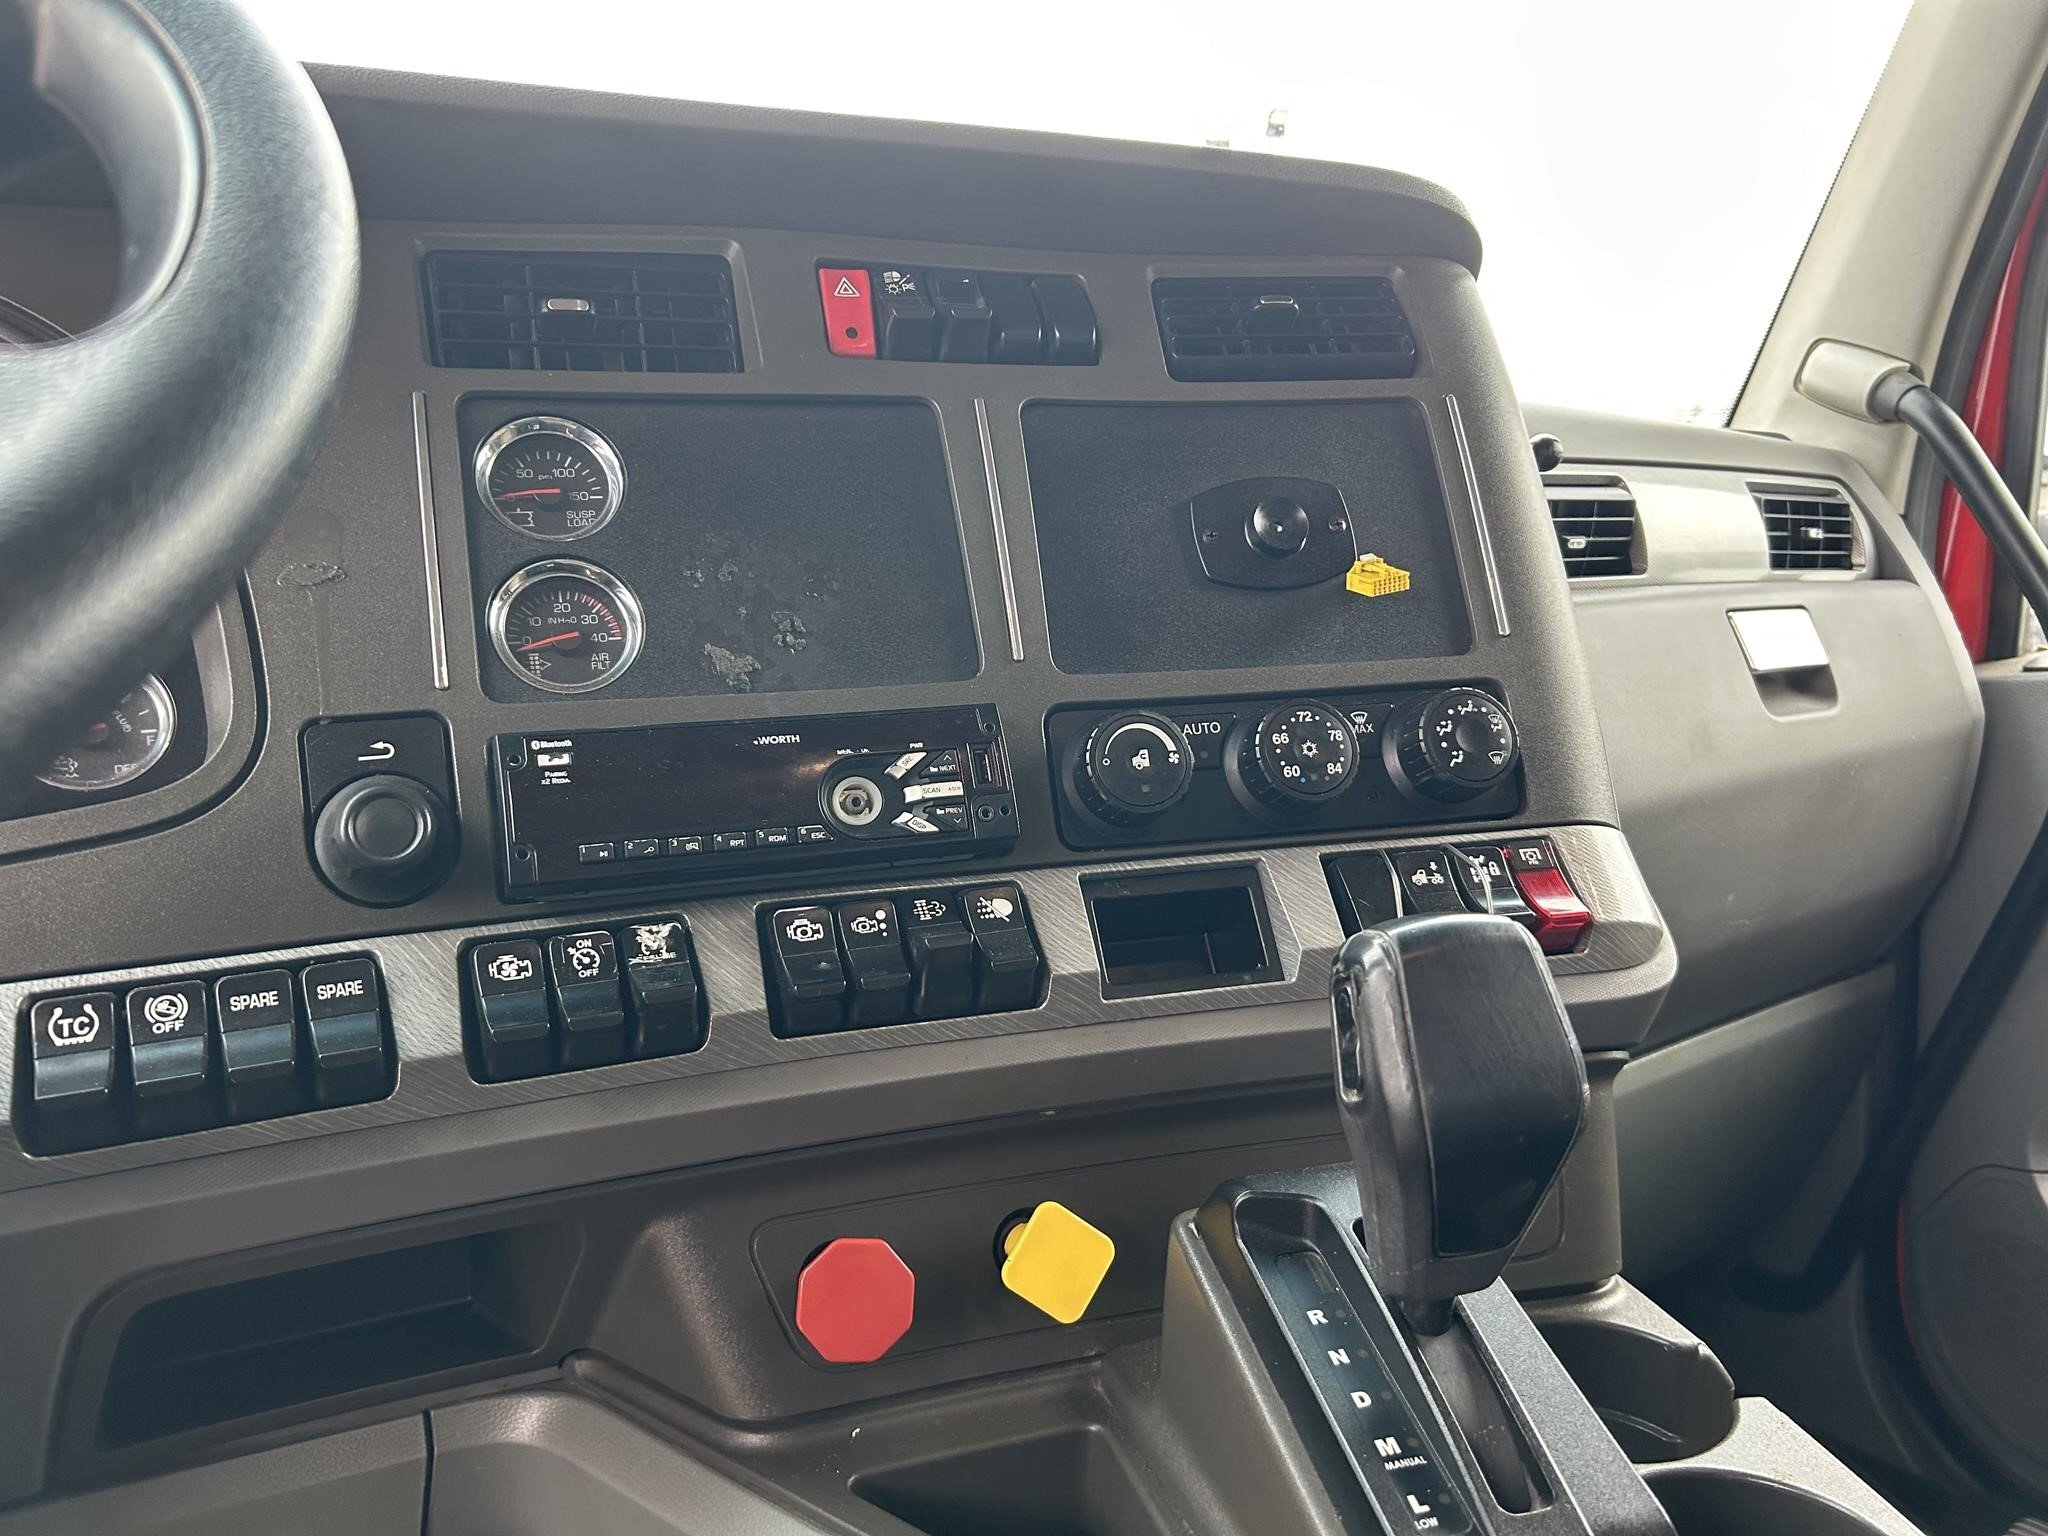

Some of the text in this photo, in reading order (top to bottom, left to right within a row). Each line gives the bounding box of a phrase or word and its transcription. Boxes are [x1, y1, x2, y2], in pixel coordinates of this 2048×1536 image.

[516, 468, 533, 479] 50
[552, 468, 576, 478] 100
[566, 510, 596, 519] SUSP
[553, 602, 572, 613] 20
[529, 616, 542, 627] 10
[580, 614, 599, 625] 30
[590, 632, 608, 643] 40
[591, 652, 609, 661] AIR
[591, 661, 611, 670] FILT
[1296, 711, 1313, 723] 72
[1182, 720, 1222, 736] AUTO
[1272, 732, 1289, 745] 66
[1327, 728, 1344, 742] 78
[540, 739, 573, 749] Bluetooth
[901, 755, 914, 767] SRC
[939, 764, 956, 772] NEXT
[1283, 765, 1301, 778] 60
[1326, 761, 1343, 775] 84
[922, 786, 941, 794] SCAN
[945, 806, 963, 815] PREV
[911, 818, 928, 831] DISP
[800, 827, 807, 835] 6
[810, 831, 826, 840] ESC
[671, 839, 678, 847] 3
[716, 835, 722, 843] 4
[729, 839, 745, 847] RPT
[768, 834, 787, 843] RDM
[627, 842, 634, 850] 2
[576, 938, 593, 949] ON
[578, 968, 600, 979] OFF
[316, 979, 365, 1001] SPARE
[229, 990, 281, 1013] SPARE
[57, 1017, 90, 1039] TC
[152, 1020, 184, 1035] OFF
[1306, 1308, 1329, 1326] R
[1327, 1348, 1351, 1367] N
[1350, 1390, 1372, 1409] D
[1374, 1436, 1402, 1458] M
[1384, 1455, 1428, 1471] MANUAL
[1406, 1494, 1431, 1515] L
[1413, 1516, 1439, 1531] LOW
